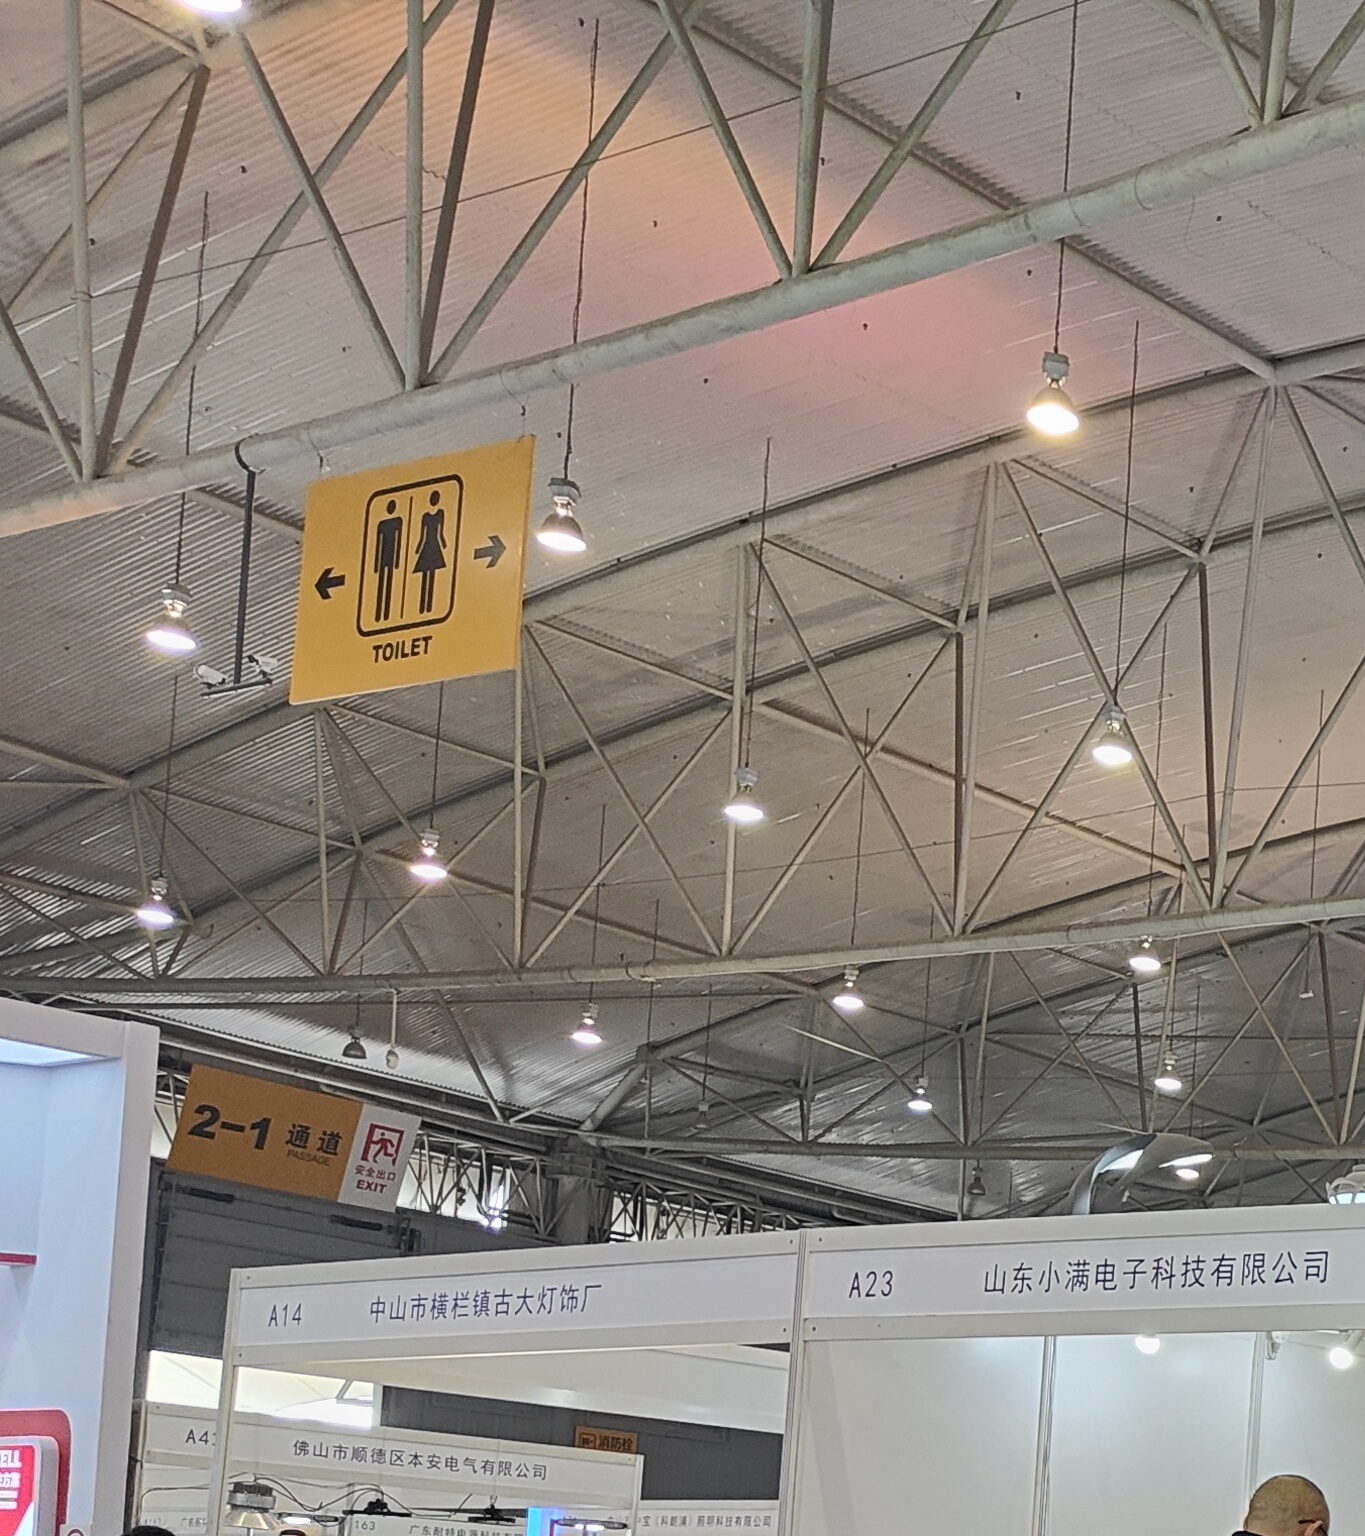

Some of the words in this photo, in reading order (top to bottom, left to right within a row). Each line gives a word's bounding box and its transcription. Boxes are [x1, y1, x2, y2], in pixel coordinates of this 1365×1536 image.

[372, 635, 432, 663] TOILET
[285, 1123, 343, 1156] 通道
[286, 1150, 331, 1167] PASSAGE
[354, 1164, 396, 1182] 安全出口
[356, 1179, 388, 1194] EXIT
[849, 1270, 894, 1299] A23
[983, 1250, 1330, 1295] 山东小满电子科技有限公司
[268, 1303, 303, 1327] A14
[370, 1285, 602, 1324] 中山市横栏镇古大灯饰厂
[185, 1429, 216, 1447] A4
[599, 1435, 634, 1451] 消防栓
[292, 1439, 548, 1481] 佛山市顺德区本安电气有限公司
